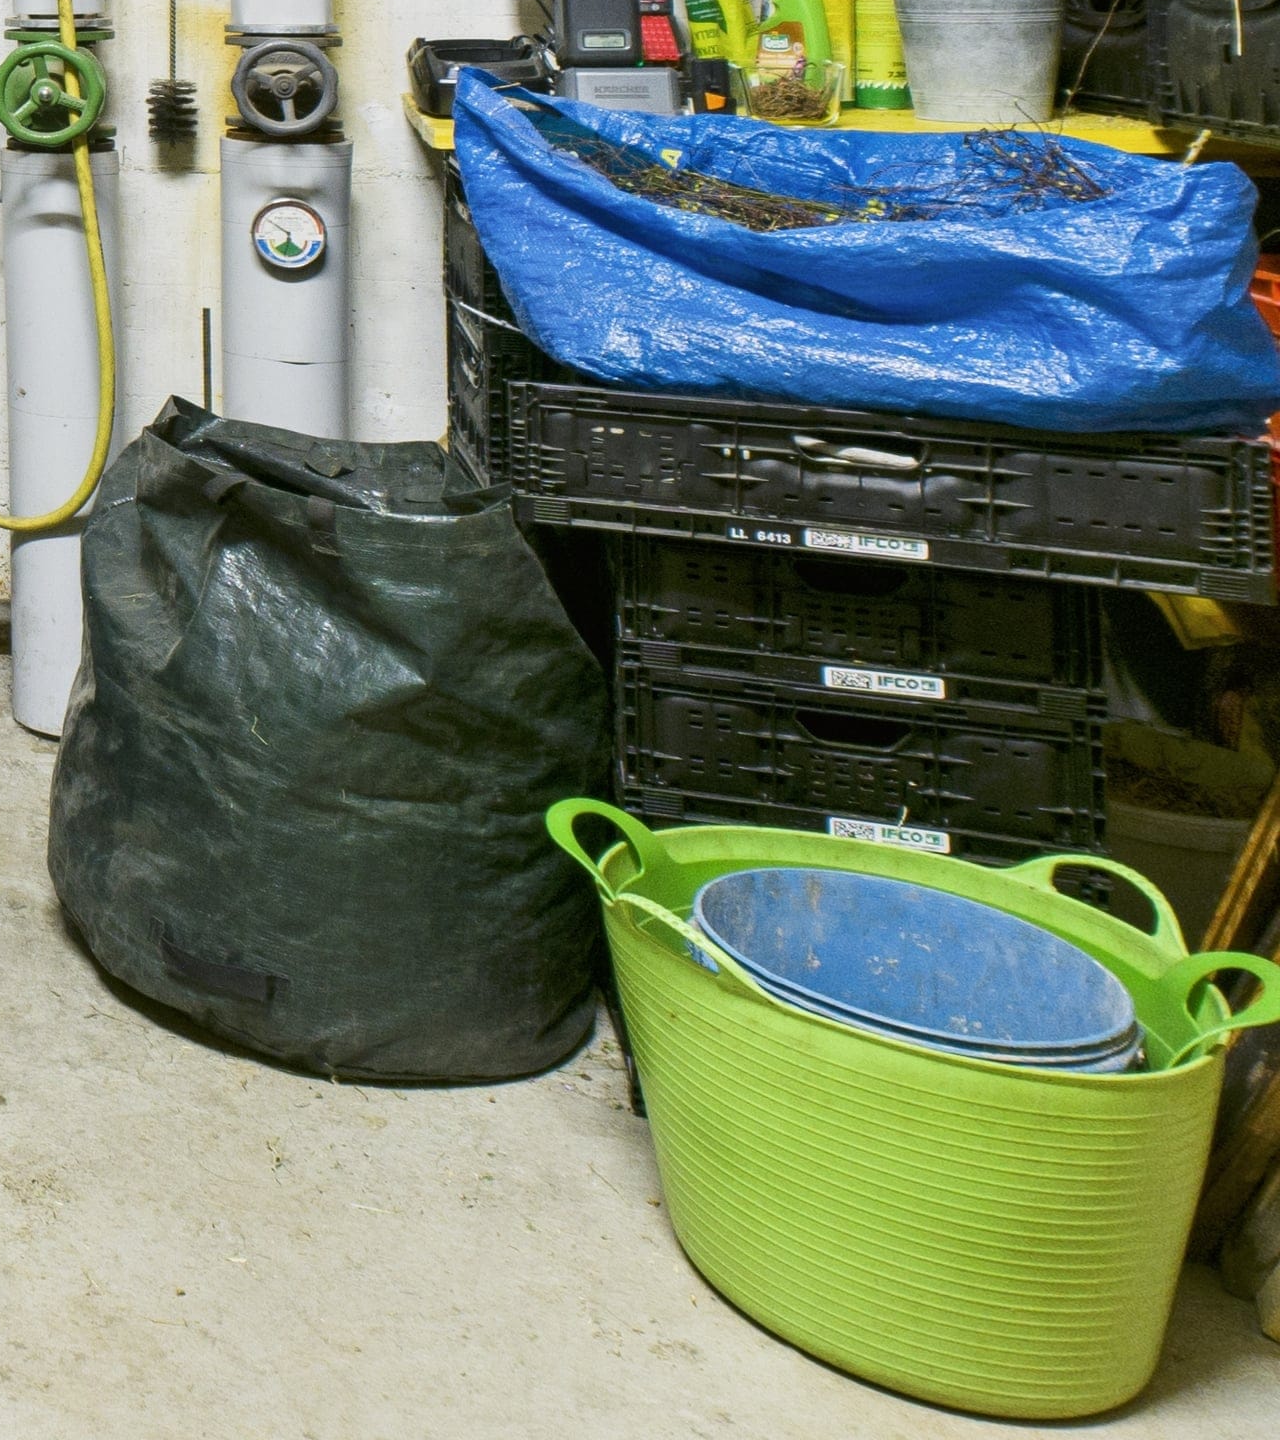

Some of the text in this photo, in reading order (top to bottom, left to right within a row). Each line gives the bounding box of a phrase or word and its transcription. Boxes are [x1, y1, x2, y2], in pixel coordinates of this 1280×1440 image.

[756, 531, 791, 545] 6413
[858, 535, 901, 550] IFCO
[877, 675, 919, 690] IFCO
[881, 827, 923, 843] IFCO
